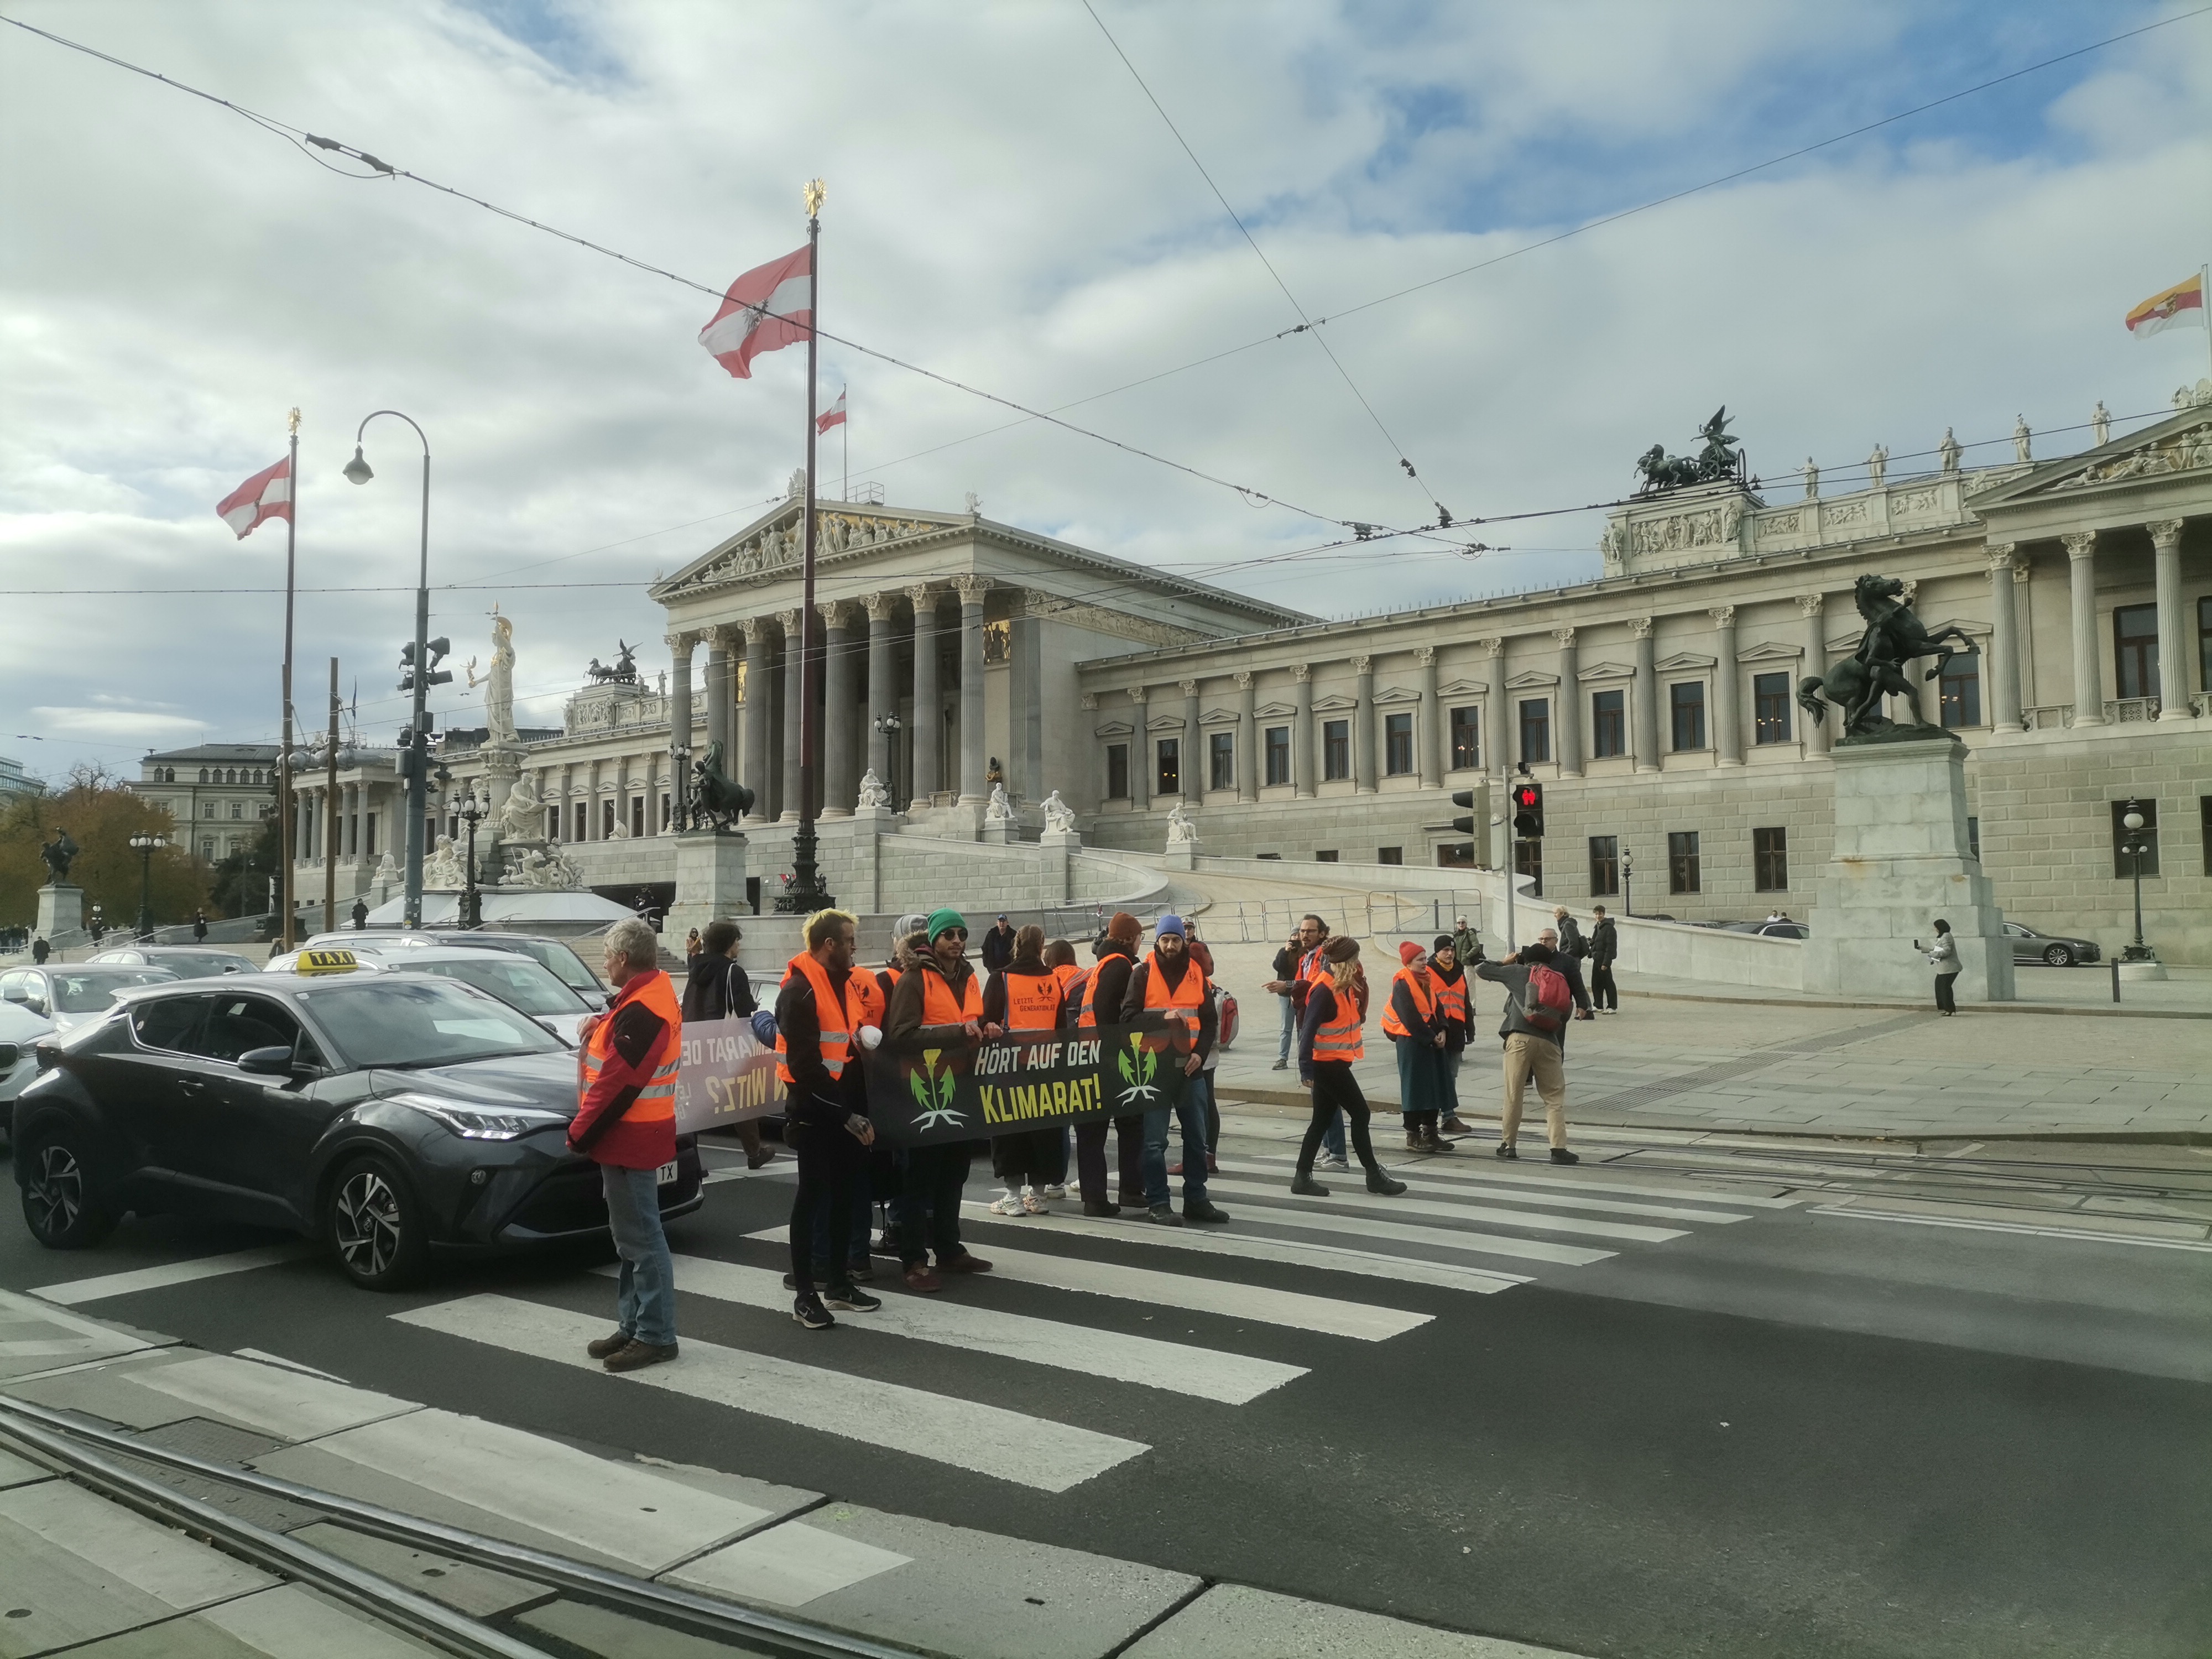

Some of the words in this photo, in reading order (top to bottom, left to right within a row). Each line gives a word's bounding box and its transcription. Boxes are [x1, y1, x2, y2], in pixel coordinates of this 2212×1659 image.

[312, 952, 353, 965] TAXI
[974, 1043, 1021, 1076] HÖRT
[1026, 1043, 1062, 1071] AUF
[1067, 1040, 1101, 1066] DEN
[979, 1073, 1102, 1124] KLIMARAT!
[660, 1164, 673, 1181] TX
